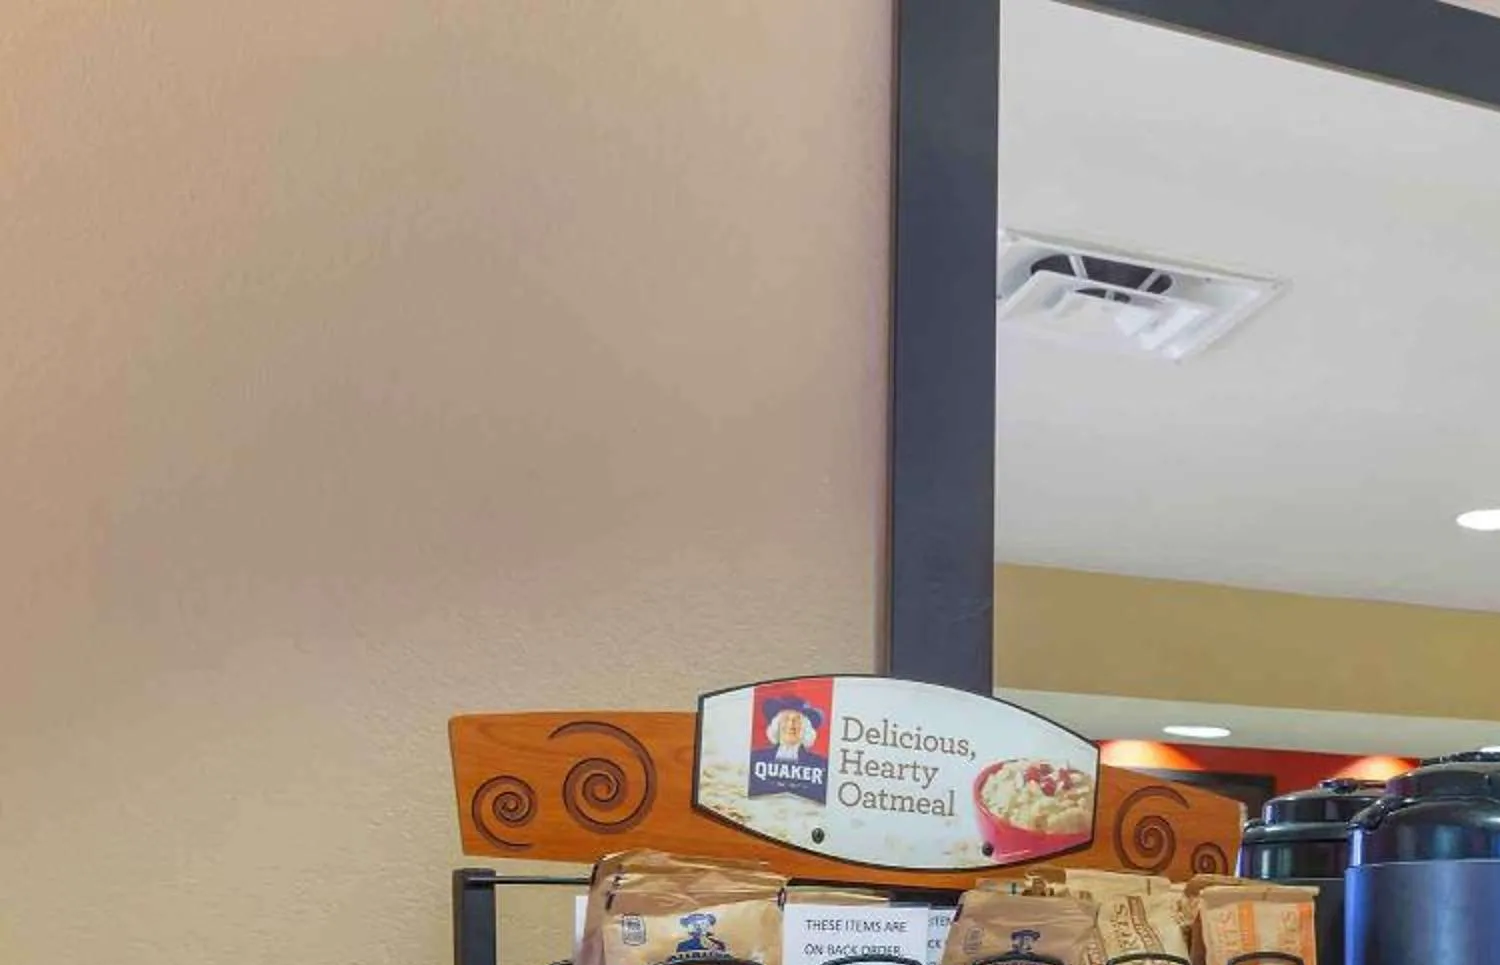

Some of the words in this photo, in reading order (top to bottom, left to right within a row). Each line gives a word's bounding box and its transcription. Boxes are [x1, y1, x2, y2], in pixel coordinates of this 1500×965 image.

[841, 716, 977, 762] Delicious,
[754, 762, 824, 785] QUAKER
[839, 748, 939, 788] Hearty
[837, 781, 957, 817] Oatmeal
[805, 919, 842, 931] THESE
[845, 920, 881, 932] ITEMS
[883, 921, 908, 932] ARE
[803, 943, 823, 955] ON
[827, 943, 858, 955] BACK
